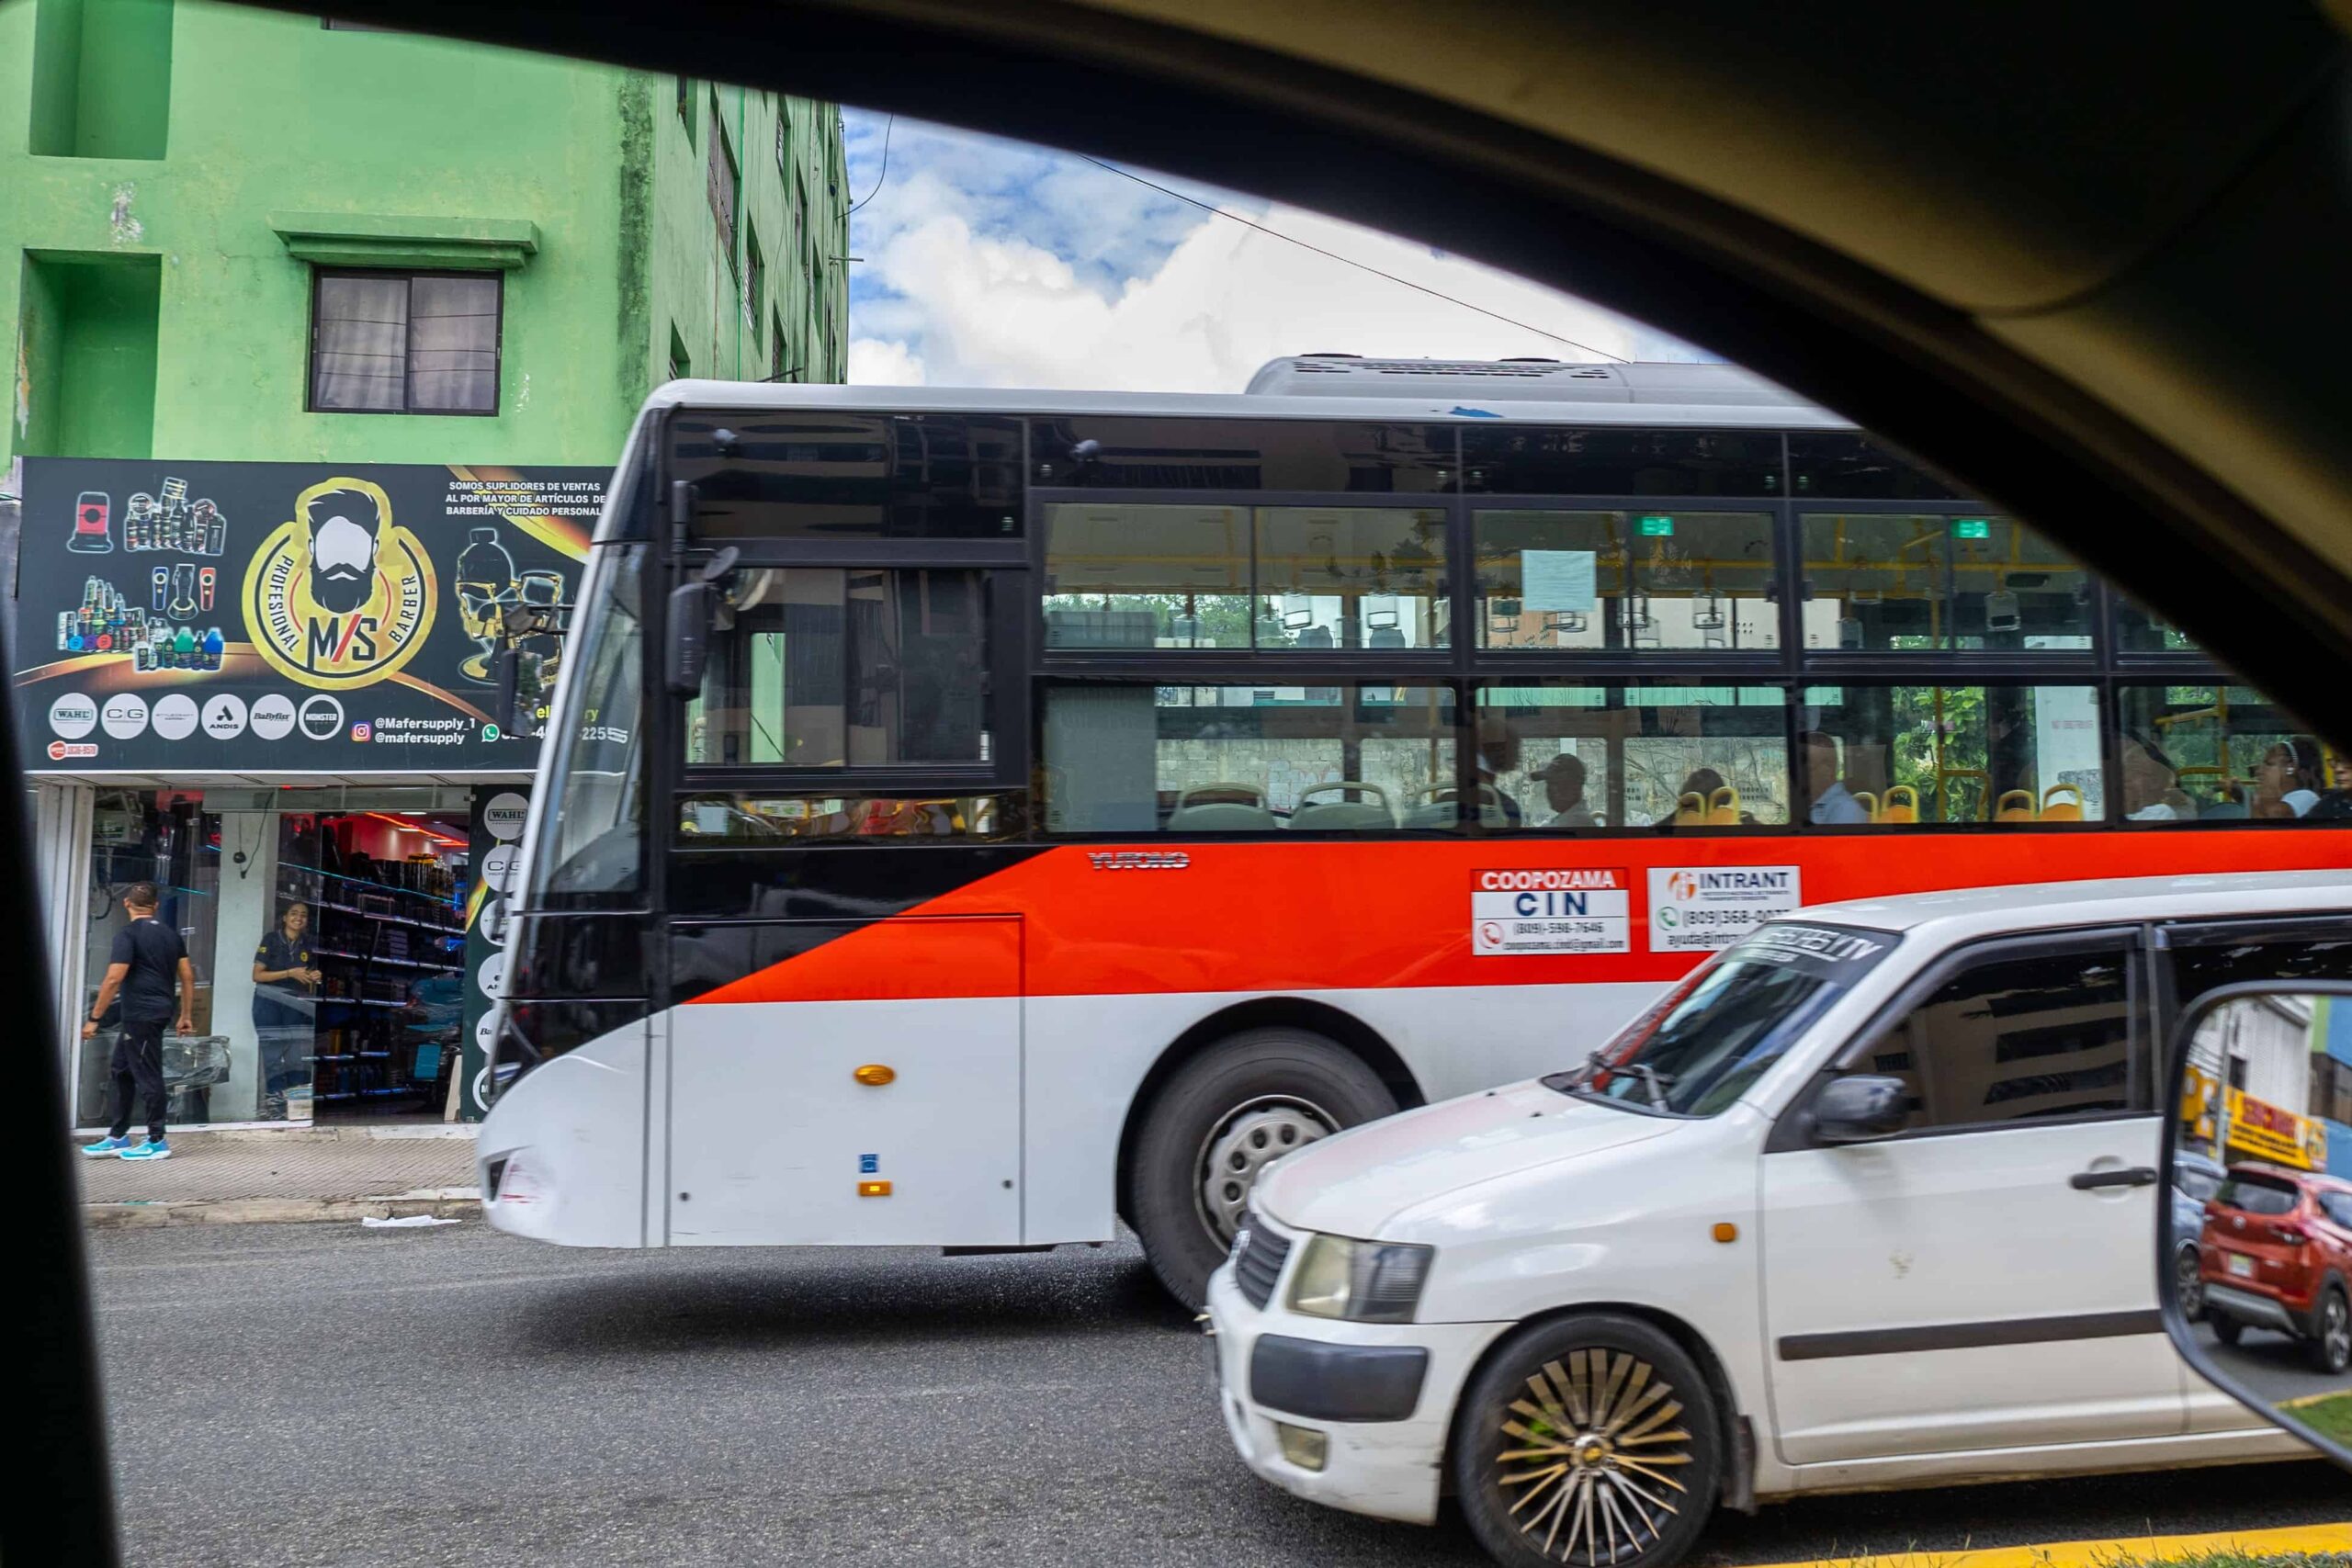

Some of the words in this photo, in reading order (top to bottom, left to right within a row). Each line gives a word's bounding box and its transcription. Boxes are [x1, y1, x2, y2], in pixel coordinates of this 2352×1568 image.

[448, 481, 483, 491] SOMOS
[486, 481, 546, 491] SUPLIDORES
[547, 482, 560, 491] DE
[562, 482, 601, 491] VENTAS
[446, 494, 458, 503] AL
[460, 494, 481, 503] POR
[482, 494, 517, 503] MAYOR
[519, 494, 533, 503] DE
[535, 492, 589, 503] ARTÍCULOS
[593, 494, 606, 503] DE
[446, 504, 494, 515] BARBERÍA
[496, 506, 504, 515] Y
[505, 506, 550, 516] CUIDADO
[551, 507, 602, 516] PERSONAL
[268, 555, 300, 652] PROFESIONAL
[389, 575, 418, 643] BARBER
[58, 710, 90, 718] WAHL
[375, 717, 476, 731] @Mafersupply_1
[375, 732, 466, 745] @mafersupply
[492, 811, 525, 819] WAHL
[1481, 871, 1618, 890] COOPOZAMA
[1700, 872, 1789, 889] INTRANT
[1515, 892, 1589, 917] CIN
